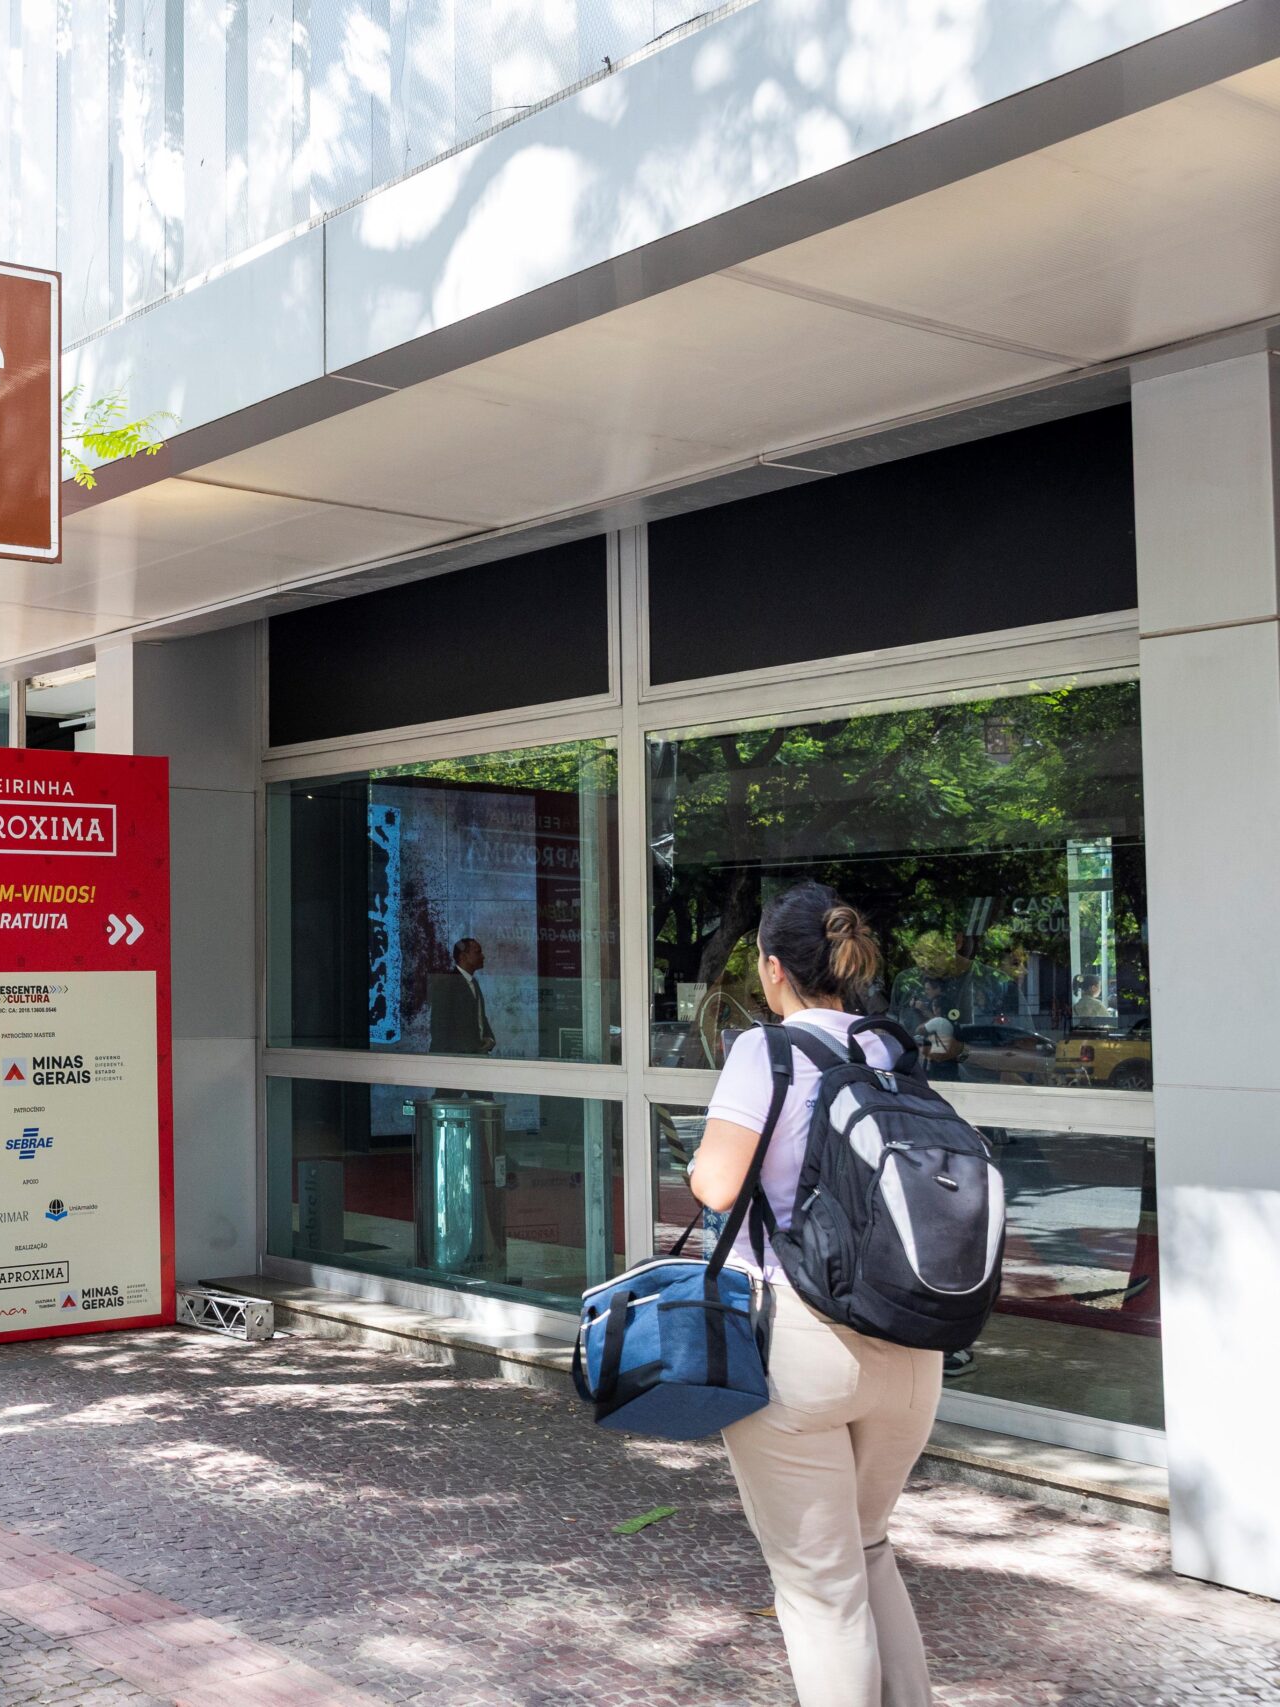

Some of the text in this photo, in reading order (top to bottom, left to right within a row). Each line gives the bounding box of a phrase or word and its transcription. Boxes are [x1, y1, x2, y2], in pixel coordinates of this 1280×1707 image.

[1012, 897, 1066, 915] CASA
[7, 994, 50, 1003] CULTURA
[32, 1055, 83, 1070] MINAS
[32, 1070, 91, 1086] GERAIS
[13, 1106, 46, 1114] PATROCÍNIO
[5, 1136, 54, 1150] SEBRAE
[14, 1242, 48, 1251] REALIZAÇÃO
[81, 1285, 119, 1299] MINAS
[81, 1296, 125, 1311] GERAIS
